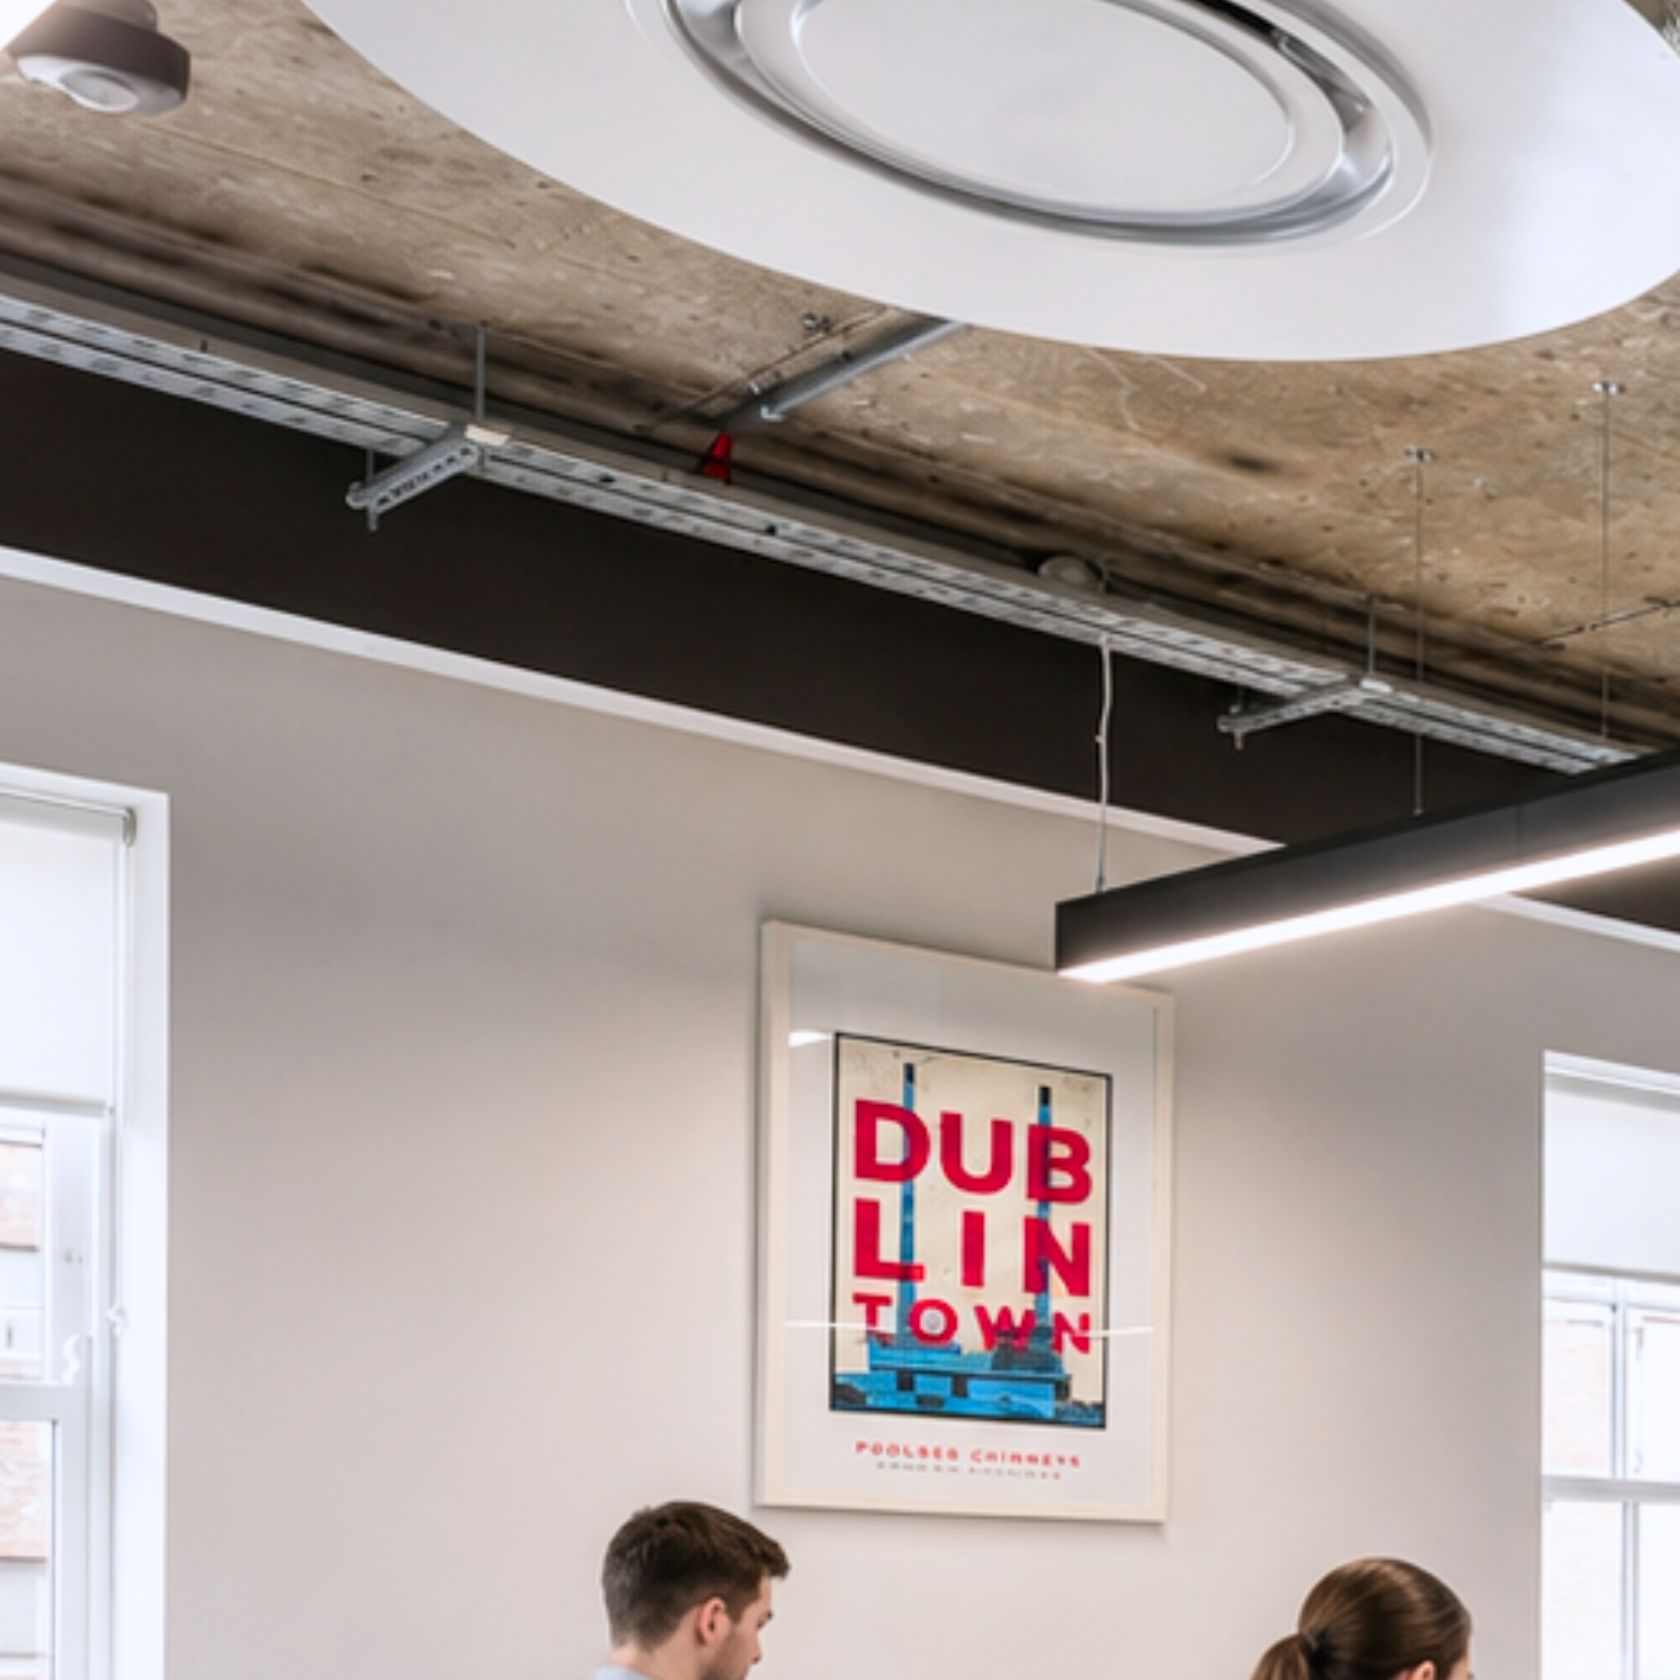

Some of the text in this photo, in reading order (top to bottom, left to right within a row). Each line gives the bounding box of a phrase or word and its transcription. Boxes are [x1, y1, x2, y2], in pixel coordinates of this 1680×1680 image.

[854, 1098, 1093, 1206] DUB
[853, 1196, 1091, 1298] LIN
[852, 1292, 1091, 1355] TOWN
